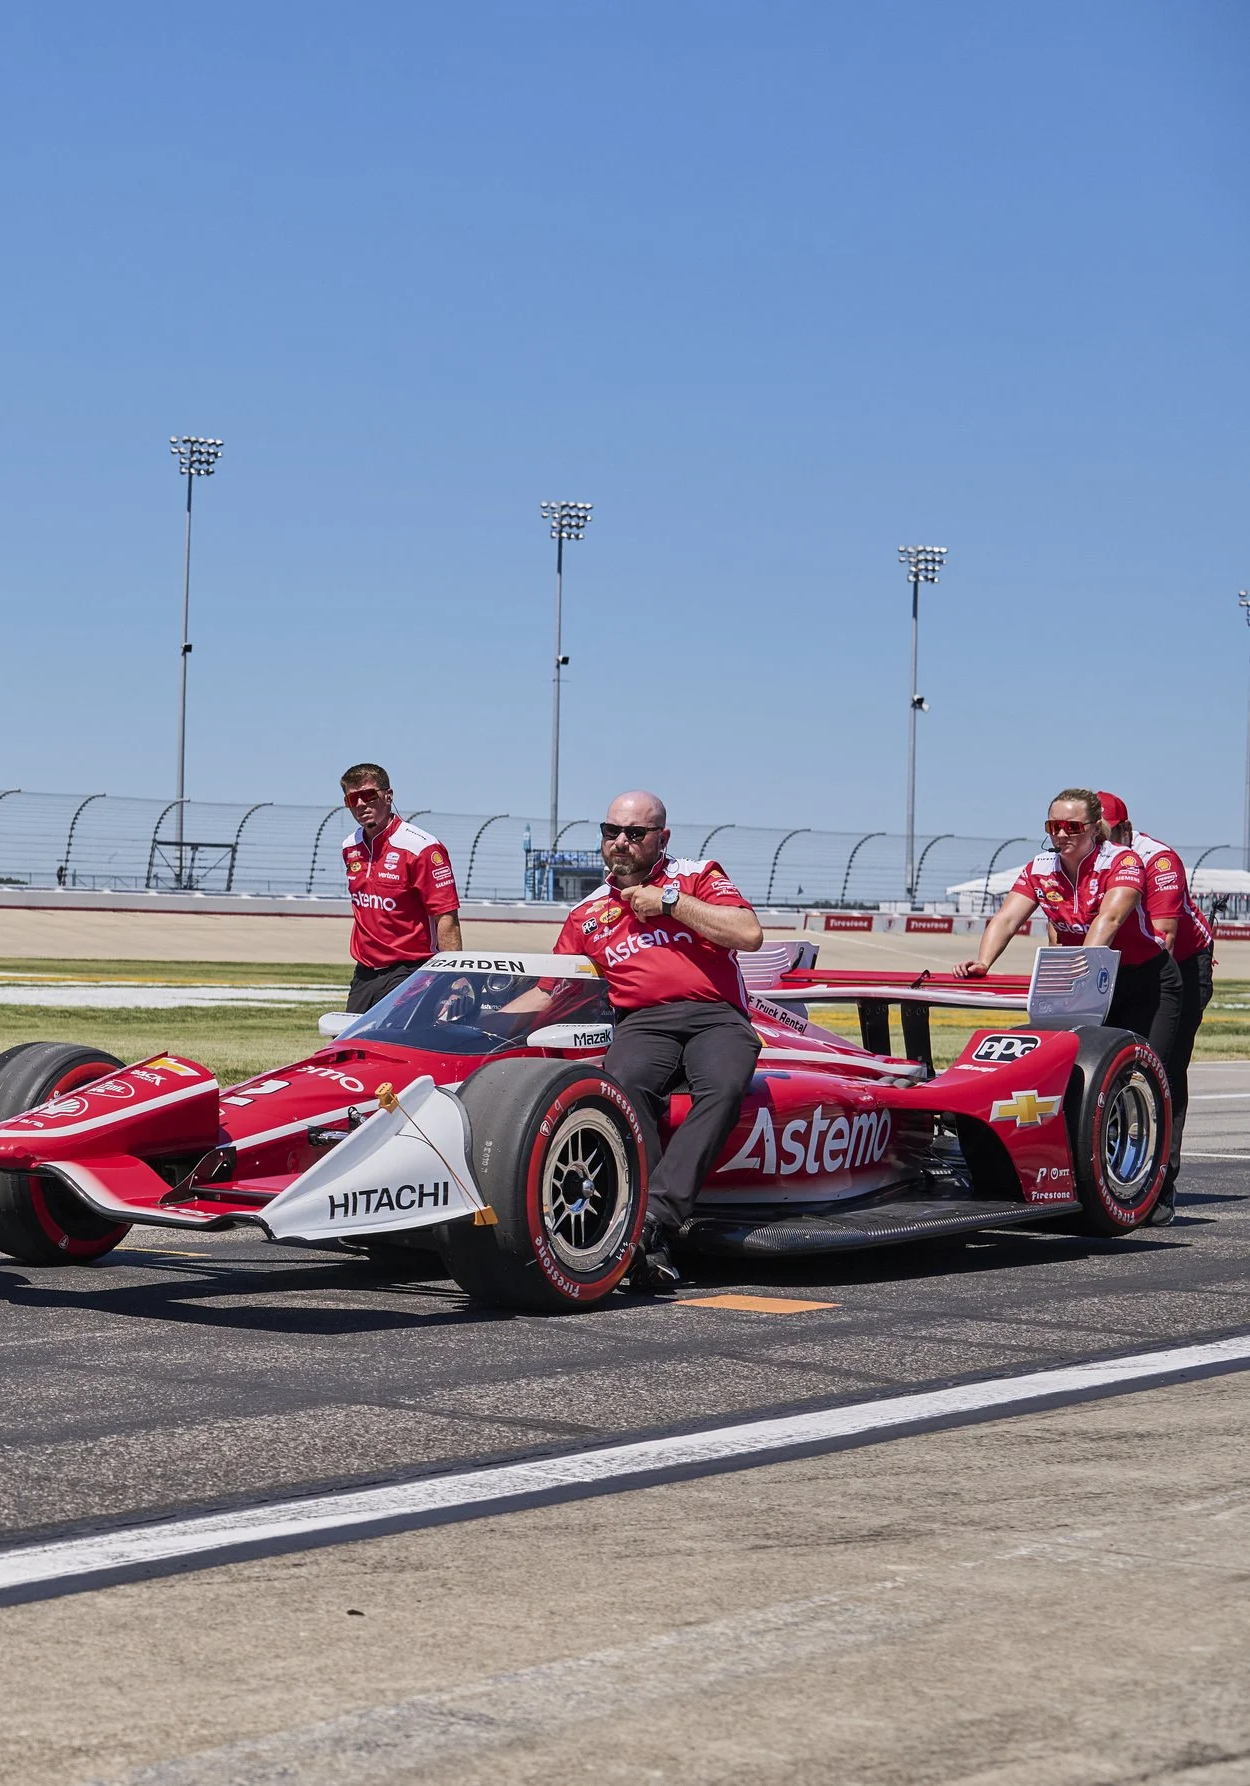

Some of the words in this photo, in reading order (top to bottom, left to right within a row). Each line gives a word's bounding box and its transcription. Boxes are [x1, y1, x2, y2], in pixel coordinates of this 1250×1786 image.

[378, 871, 400, 881] verizon
[1115, 875, 1140, 883] SIEMENS
[350, 890, 397, 912] stemo
[830, 919, 868, 929] Firestone
[911, 920, 949, 930] Firestone
[755, 998, 779, 1019] Truck
[779, 1012, 808, 1034] Rental
[573, 1029, 612, 1047] Mazak
[977, 1038, 1036, 1060] PPG
[1134, 1046, 1171, 1099] Firestone
[600, 1081, 644, 1144] Firestone
[716, 1104, 892, 1175] Astemo
[328, 1181, 449, 1220] HITACHI
[1031, 1191, 1071, 1201] Firestone
[1098, 1176, 1136, 1225] Firestone
[535, 1235, 581, 1298] Firestone
